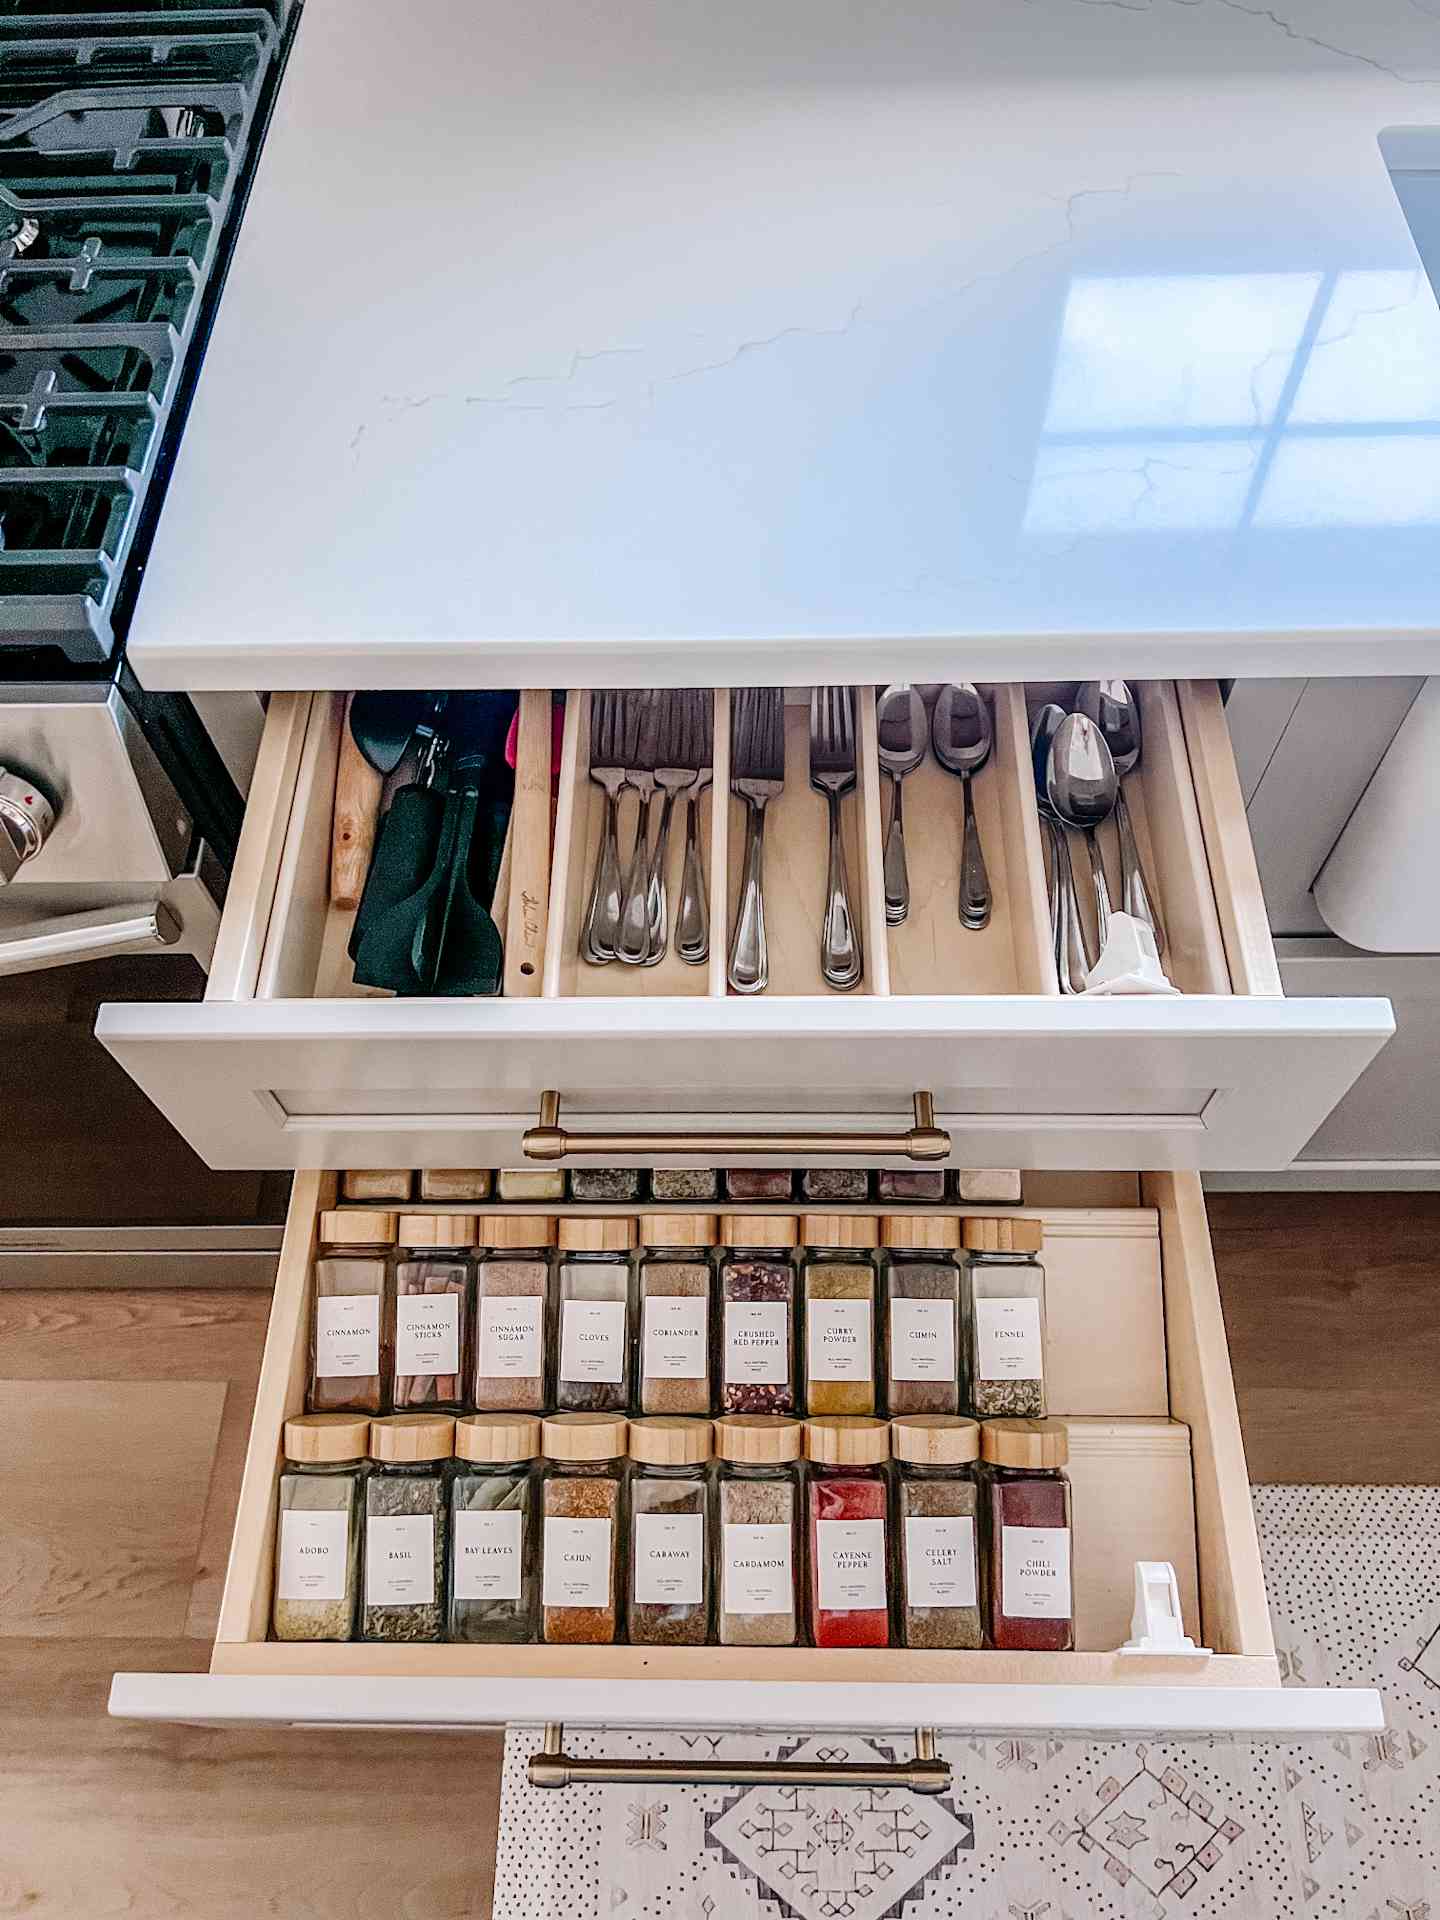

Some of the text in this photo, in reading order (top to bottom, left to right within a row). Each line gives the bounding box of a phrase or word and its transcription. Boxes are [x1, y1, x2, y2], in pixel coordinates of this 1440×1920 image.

[406, 1322, 451, 1331] CINNAMON
[489, 1325, 534, 1333] CINNAMON
[326, 1328, 371, 1337] CINNAMON
[414, 1331, 442, 1339] STICKS
[652, 1329, 699, 1337] CORIANDER
[738, 1330, 775, 1338] CRUSHED
[826, 1327, 854, 1335] CURRY
[909, 1331, 937, 1339] CUMIN
[994, 1330, 1025, 1338] FENNEL
[498, 1333, 525, 1341] SUGAR
[578, 1333, 609, 1342] CLOVES
[823, 1335, 857, 1343] POWDER
[733, 1338, 779, 1346] RED PEPPER
[464, 1546, 513, 1554] BAY LEAVES
[925, 1548, 957, 1557] CELERY
[388, 1551, 412, 1560] BASIL
[563, 1553, 592, 1562] CAJUN
[649, 1550, 690, 1559] CARAWAY
[832, 1551, 872, 1559] CAYENNE
[732, 1560, 785, 1568] CARDAMOM
[837, 1560, 868, 1568] PEPPER
[931, 1558, 952, 1566] SALT
[1019, 1568, 1057, 1577] POWDER
